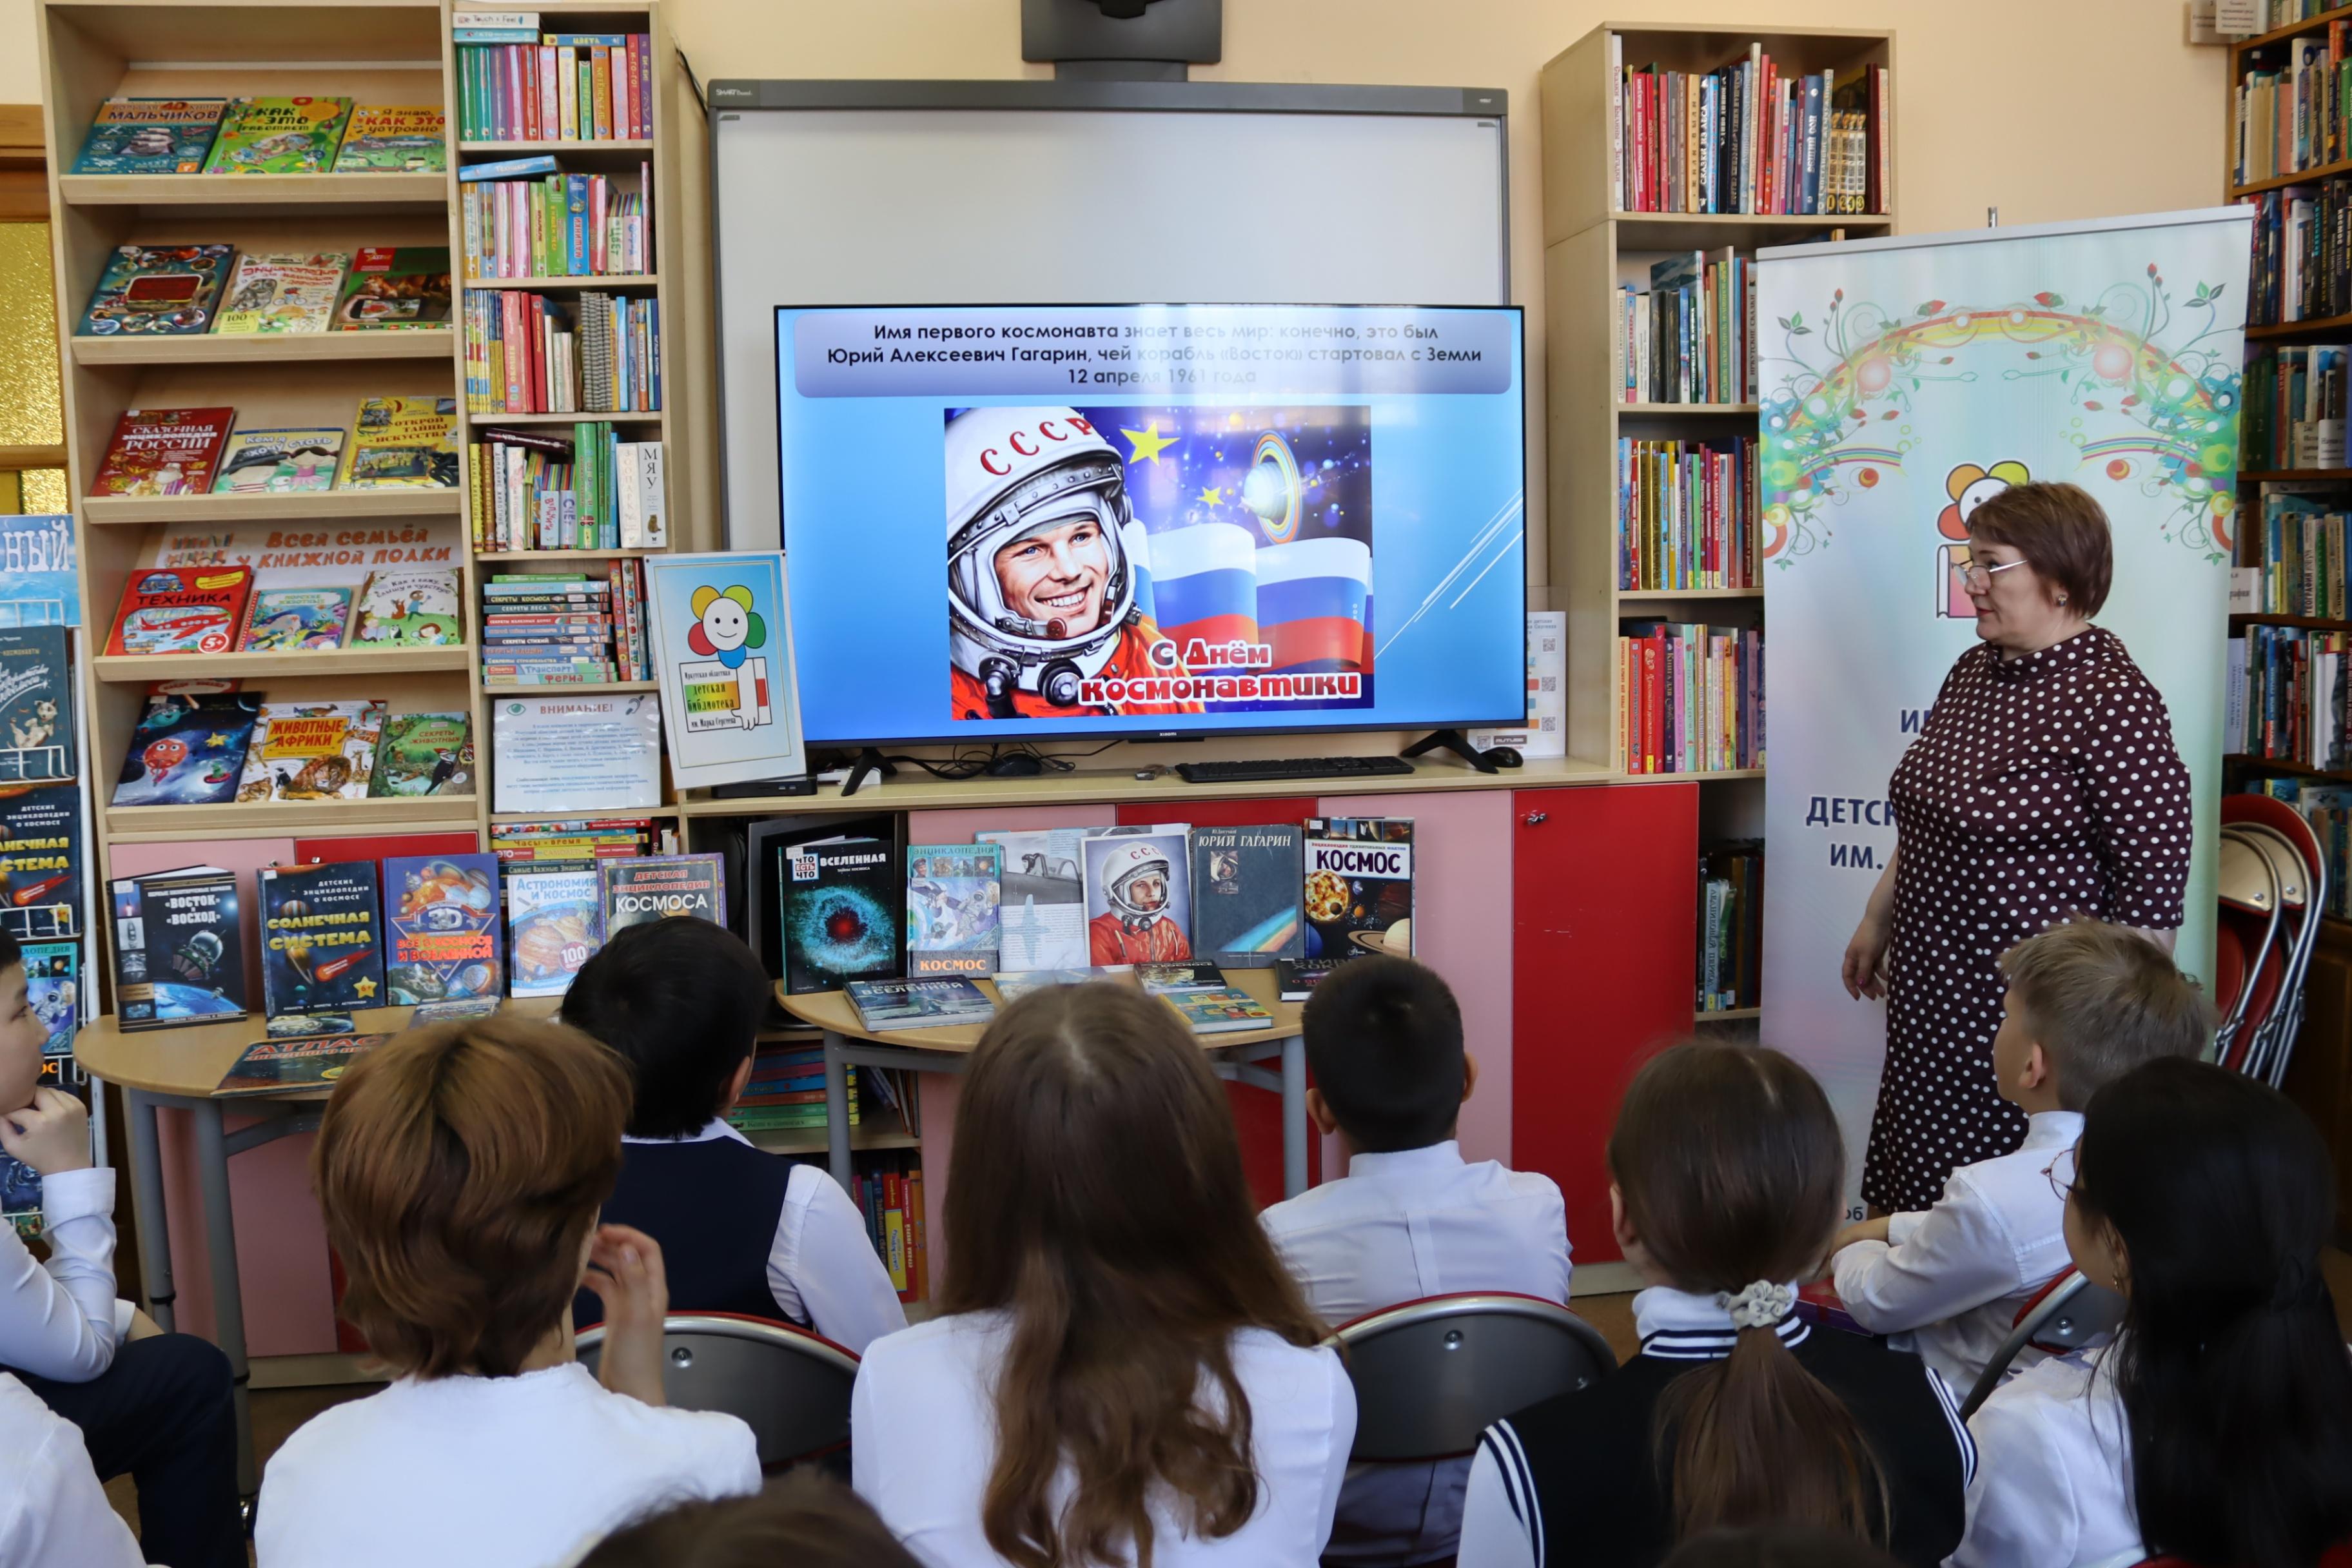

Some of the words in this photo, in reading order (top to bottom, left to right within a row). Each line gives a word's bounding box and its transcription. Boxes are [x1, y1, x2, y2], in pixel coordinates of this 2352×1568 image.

[108, 112, 219, 120] МАЛЬЧИКОВ
[256, 108, 295, 116] КАК
[415, 117, 446, 125] ЭТО
[1700, 132, 1707, 142] ИЗ
[1614, 148, 1622, 182] Загадки
[574, 217, 583, 258] МАШИНКИ
[226, 314, 248, 322] 100
[874, 326, 911, 339] Имя
[917, 327, 995, 342] первого
[1002, 326, 1118, 339] космонавта
[1124, 326, 1177, 338] знает
[1184, 326, 1225, 338] весь
[1233, 326, 1273, 340] мир:
[1280, 326, 1360, 340] конечно,
[1367, 326, 1398, 338] это
[1404, 323, 1438, 338] был
[828, 348, 883, 366] Юрий
[890, 348, 1004, 362] Алексеевич
[1012, 347, 1092, 364] Гагарин,
[1098, 345, 1132, 360] чей
[1137, 346, 1215, 366] корабль
[1308, 349, 1405, 366] стартовал
[1411, 351, 1421, 361] с
[1427, 348, 1482, 362] Земли
[1068, 369, 1088, 383] 12
[1094, 371, 1161, 386] апреля
[1169, 369, 1206, 383] 1961
[1215, 371, 1257, 385] года
[393, 416, 444, 426] ОТКРОЙ
[403, 423, 448, 433] ТАЙНЫ
[122, 432, 217, 440] ЭНЦИКЛОПЕДИЯ
[133, 425, 213, 435] СКАЗОЧНАЯ
[376, 431, 447, 443] ИСКУССТВА
[126, 438, 210, 450] РОССИИ
[250, 444, 282, 456] хочу
[289, 436, 333, 448] стать
[981, 418, 1092, 475] СССР
[644, 448, 658, 490] МЯУ
[266, 532, 328, 548] Всей
[336, 524, 429, 546] семьёй
[3, 519, 70, 573] НЫЙ
[137, 594, 231, 605] ТЕХНИКА
[2304, 573, 2313, 614] ГЕОГРАФИЯ
[204, 637, 223, 647] 5+
[1152, 642, 1175, 667] С
[1186, 640, 1269, 666] Днём
[693, 683, 725, 696] детская
[1081, 674, 1358, 701] космонавтики
[540, 704, 612, 714] ВНИМАНИЕ!
[687, 699, 734, 710] библиотека
[270, 720, 344, 734] ЖИВОТНЫЕ
[700, 719, 714, 727] Марка
[716, 717, 736, 727] Сергеева
[276, 733, 333, 747] АФРИКИ
[6, 811, 70, 820] ЭНЦИКЛОПЕДИИ
[1199, 834, 1235, 847] ЮРИЙ
[1240, 835, 1291, 847] ГАГАРИН
[497, 850, 514, 858] ЭТО
[914, 847, 994, 856] ЭНЦИКЛОПЕДИЯ
[1830, 843, 1883, 869] ИМ.
[1, 856, 69, 872] СТЕМА
[819, 853, 886, 867] ВСЕЛЕННАЯ
[1317, 850, 1400, 874] КОСМОС
[634, 870, 688, 881] ДЕТСКАЯ
[303, 886, 369, 896] ЭНЦИКЛОПЕДИИ
[516, 877, 598, 892] Астрономия
[612, 880, 710, 893] ЭНЦИКЛОПЕДИЯ
[165, 894, 220, 909] «ВОСТОК»
[616, 894, 708, 913] КОСМОСА
[166, 910, 221, 925] «ВОСХОД»
[268, 912, 369, 929] СОЛНЕЧНАЯ
[429, 908, 462, 930] 3D
[269, 930, 371, 950] СИСТЕМА
[435, 935, 493, 946] КОСМОСЕ
[398, 951, 407, 961] И
[410, 946, 493, 961] ВСЕЛЕННОЙ
[561, 946, 587, 964] 100
[920, 959, 986, 971] КОСМОС
[861, 982, 964, 995] ВСЕЛЕННОЙ
[250, 1035, 383, 1055] АТЛАС
